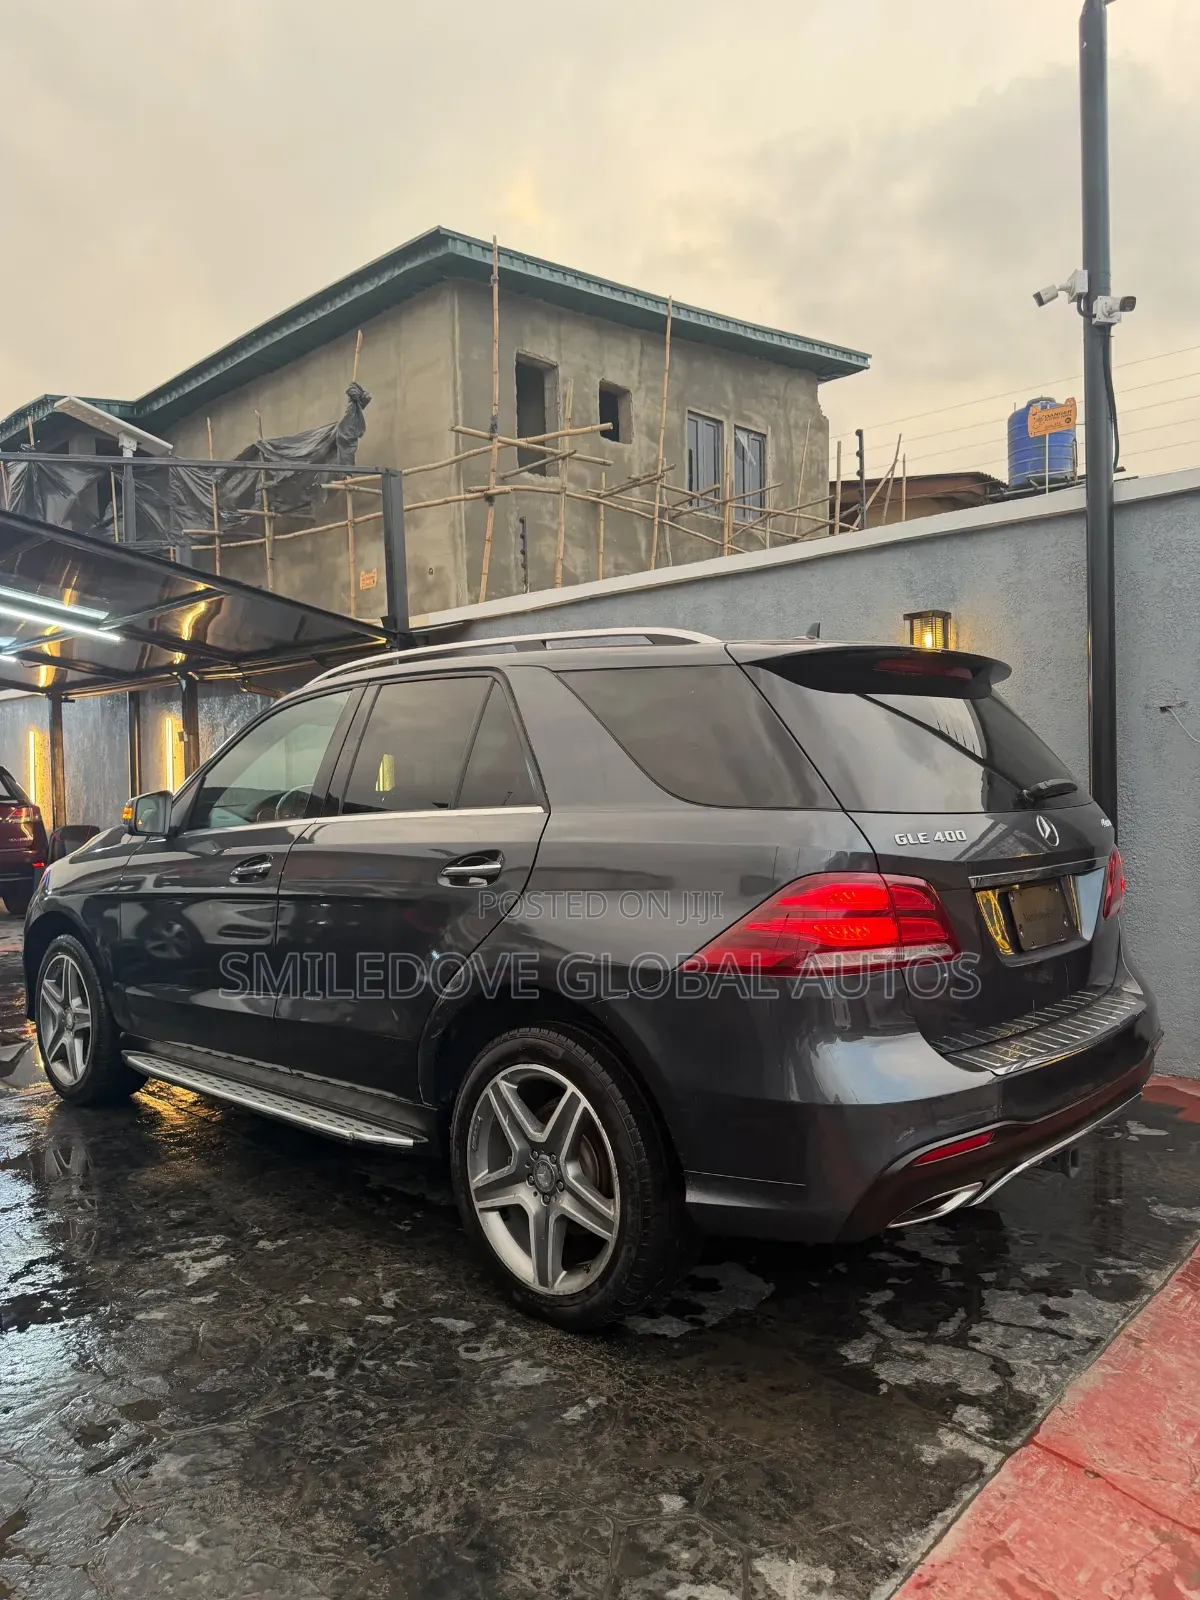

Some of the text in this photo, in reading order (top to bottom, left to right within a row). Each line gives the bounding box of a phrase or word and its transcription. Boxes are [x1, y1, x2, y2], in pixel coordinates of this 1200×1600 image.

[1044, 410, 1072, 418] DANGER
[894, 829, 967, 846] GLE 400
